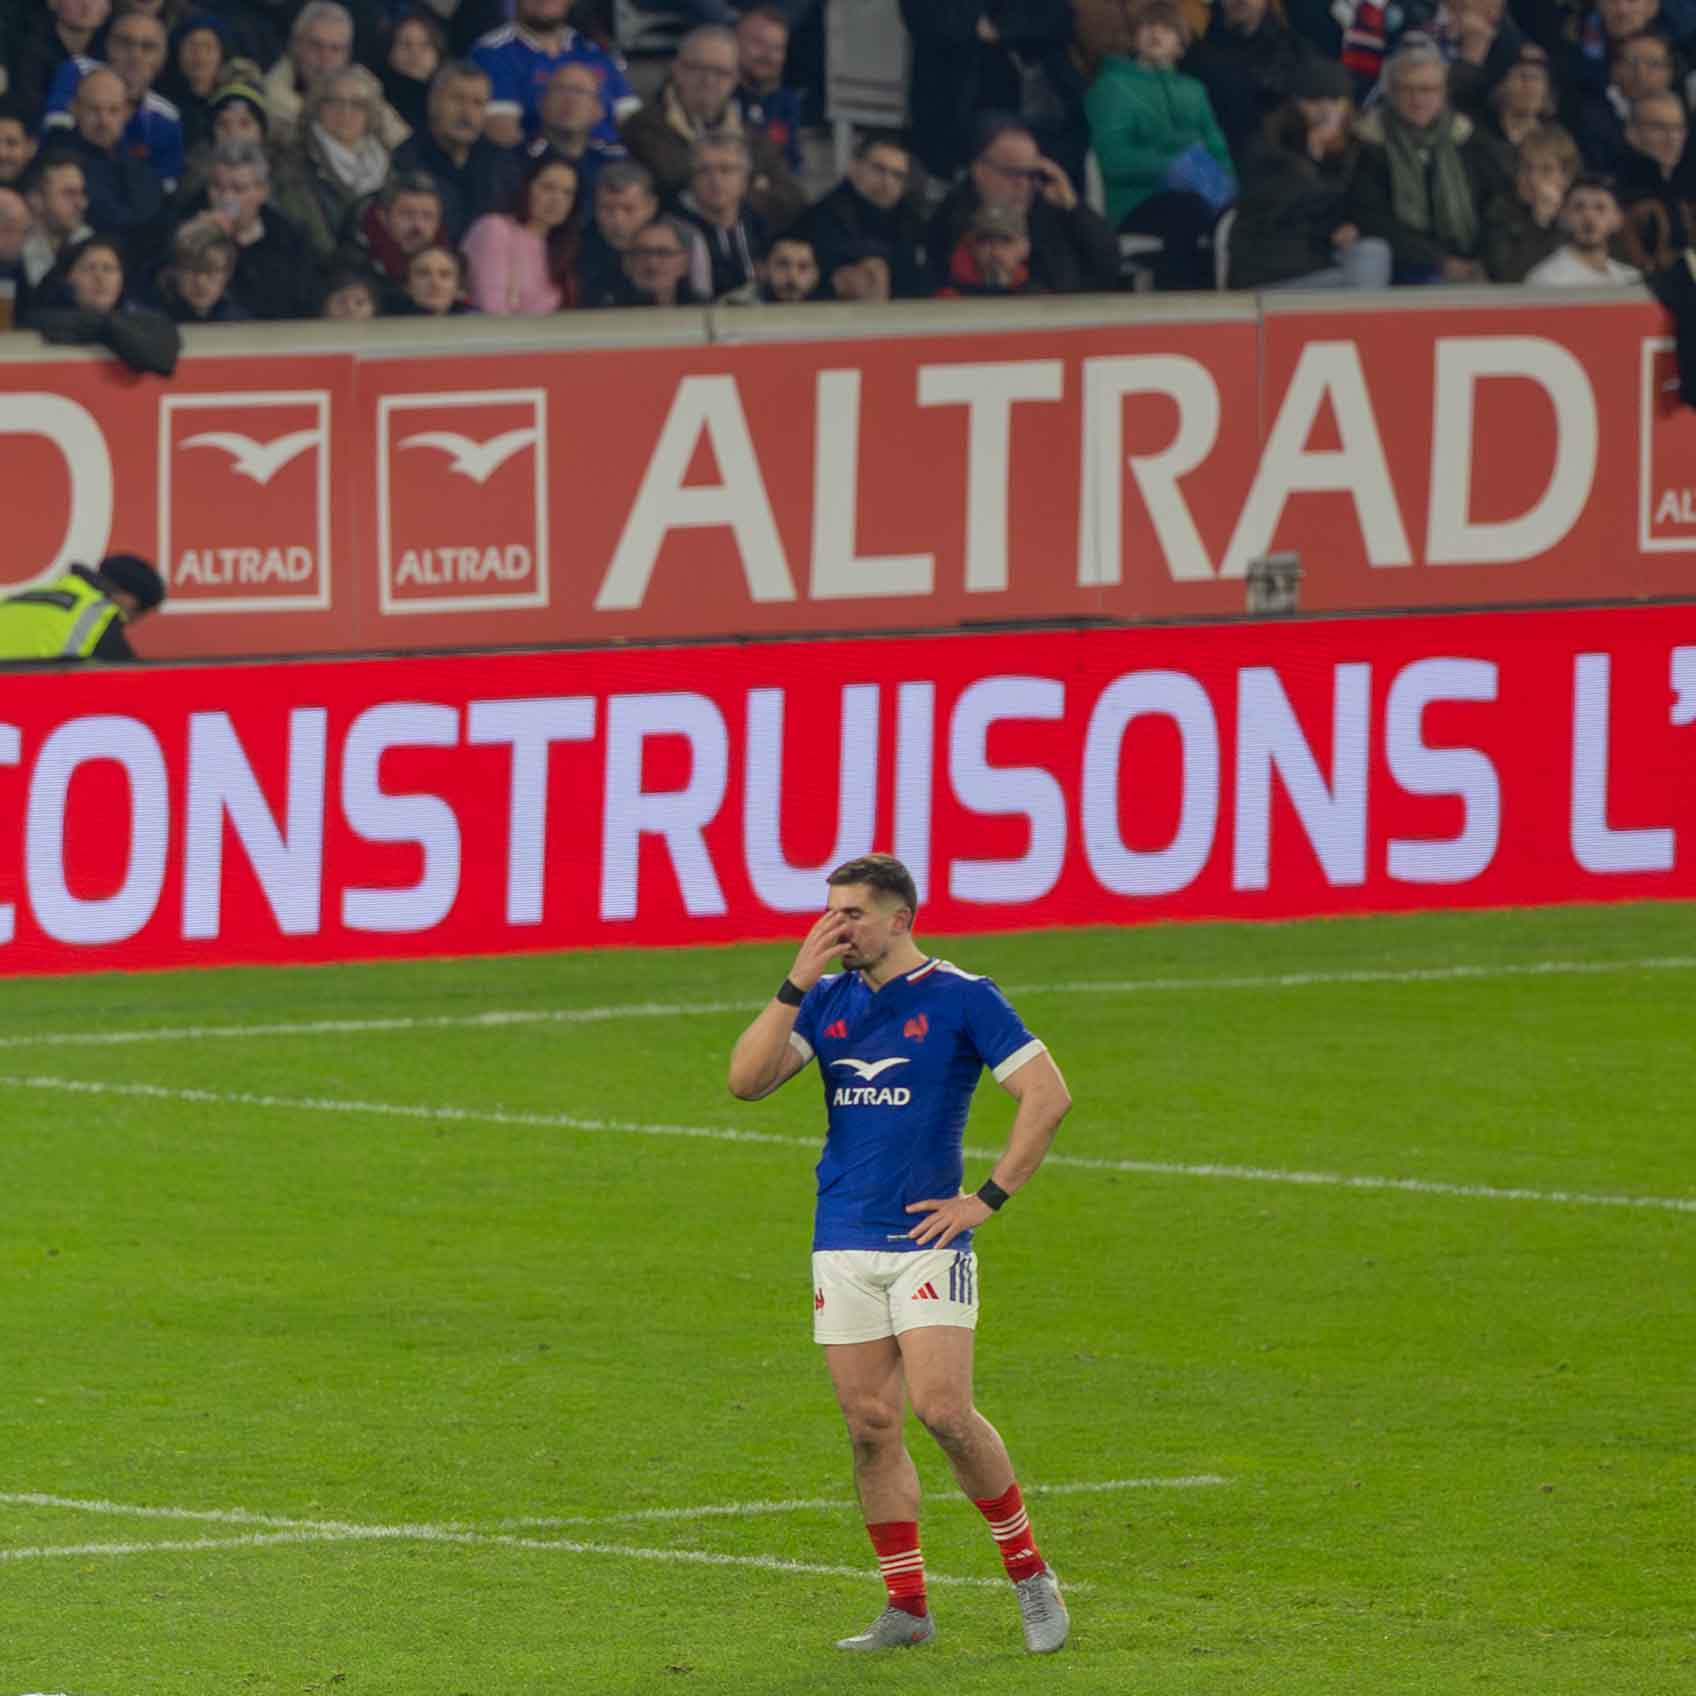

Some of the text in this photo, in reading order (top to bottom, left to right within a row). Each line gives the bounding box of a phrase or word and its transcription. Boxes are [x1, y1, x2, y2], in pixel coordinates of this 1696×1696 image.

[594, 334, 1599, 610] ALTRAD
[175, 546, 313, 585] ALTRAD
[395, 544, 532, 584] ALTRAD
[833, 1087, 911, 1106] ALTRAD
